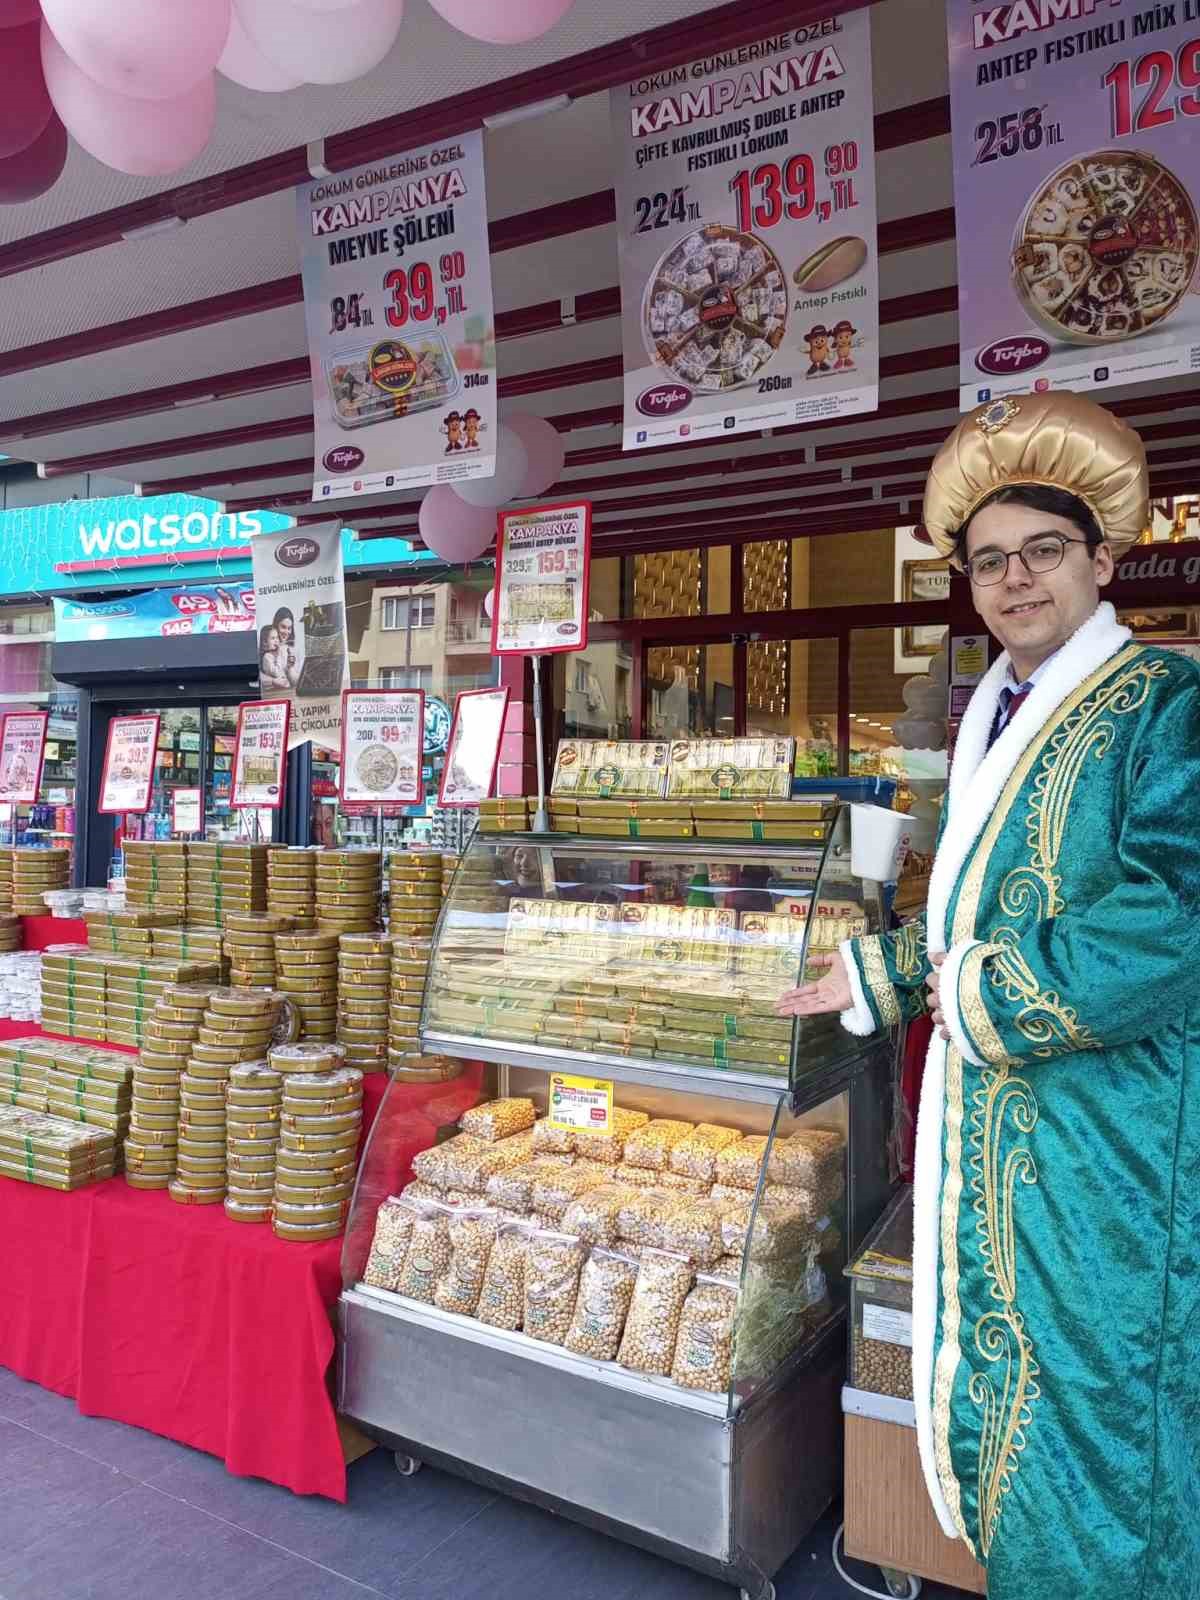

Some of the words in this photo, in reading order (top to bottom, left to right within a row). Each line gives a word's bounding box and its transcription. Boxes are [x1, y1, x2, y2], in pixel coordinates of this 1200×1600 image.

[976, 48, 1038, 86] ANTEP
[1044, 25, 1125, 64] FISTIKLI
[630, 67, 687, 97] LOKUM
[631, 46, 846, 137] KAMPANYA
[635, 143, 669, 169] ÇİFTE
[672, 118, 751, 154] KAVRULMUŞ
[754, 104, 797, 131] DUBLE
[800, 89, 845, 116] ANTEP
[687, 143, 737, 172] FISTIKLI
[740, 129, 788, 157] LOKUM
[310, 179, 353, 201] LOKUM
[355, 158, 428, 189] GÜNLERİNE
[430, 144, 466, 166] ÖZEL
[312, 168, 468, 235] KAMPANYA
[328, 229, 389, 266] MEYVE
[393, 204, 455, 256] ŞÖLENİ
[794, 296, 829, 312] Antep
[831, 286, 868, 303] Fıstıklı
[80, 511, 262, 556] watsons
[508, 521, 579, 541] KAMPANYA
[317, 576, 337, 587] ÖZEL
[300, 704, 331, 717] YAPIMI
